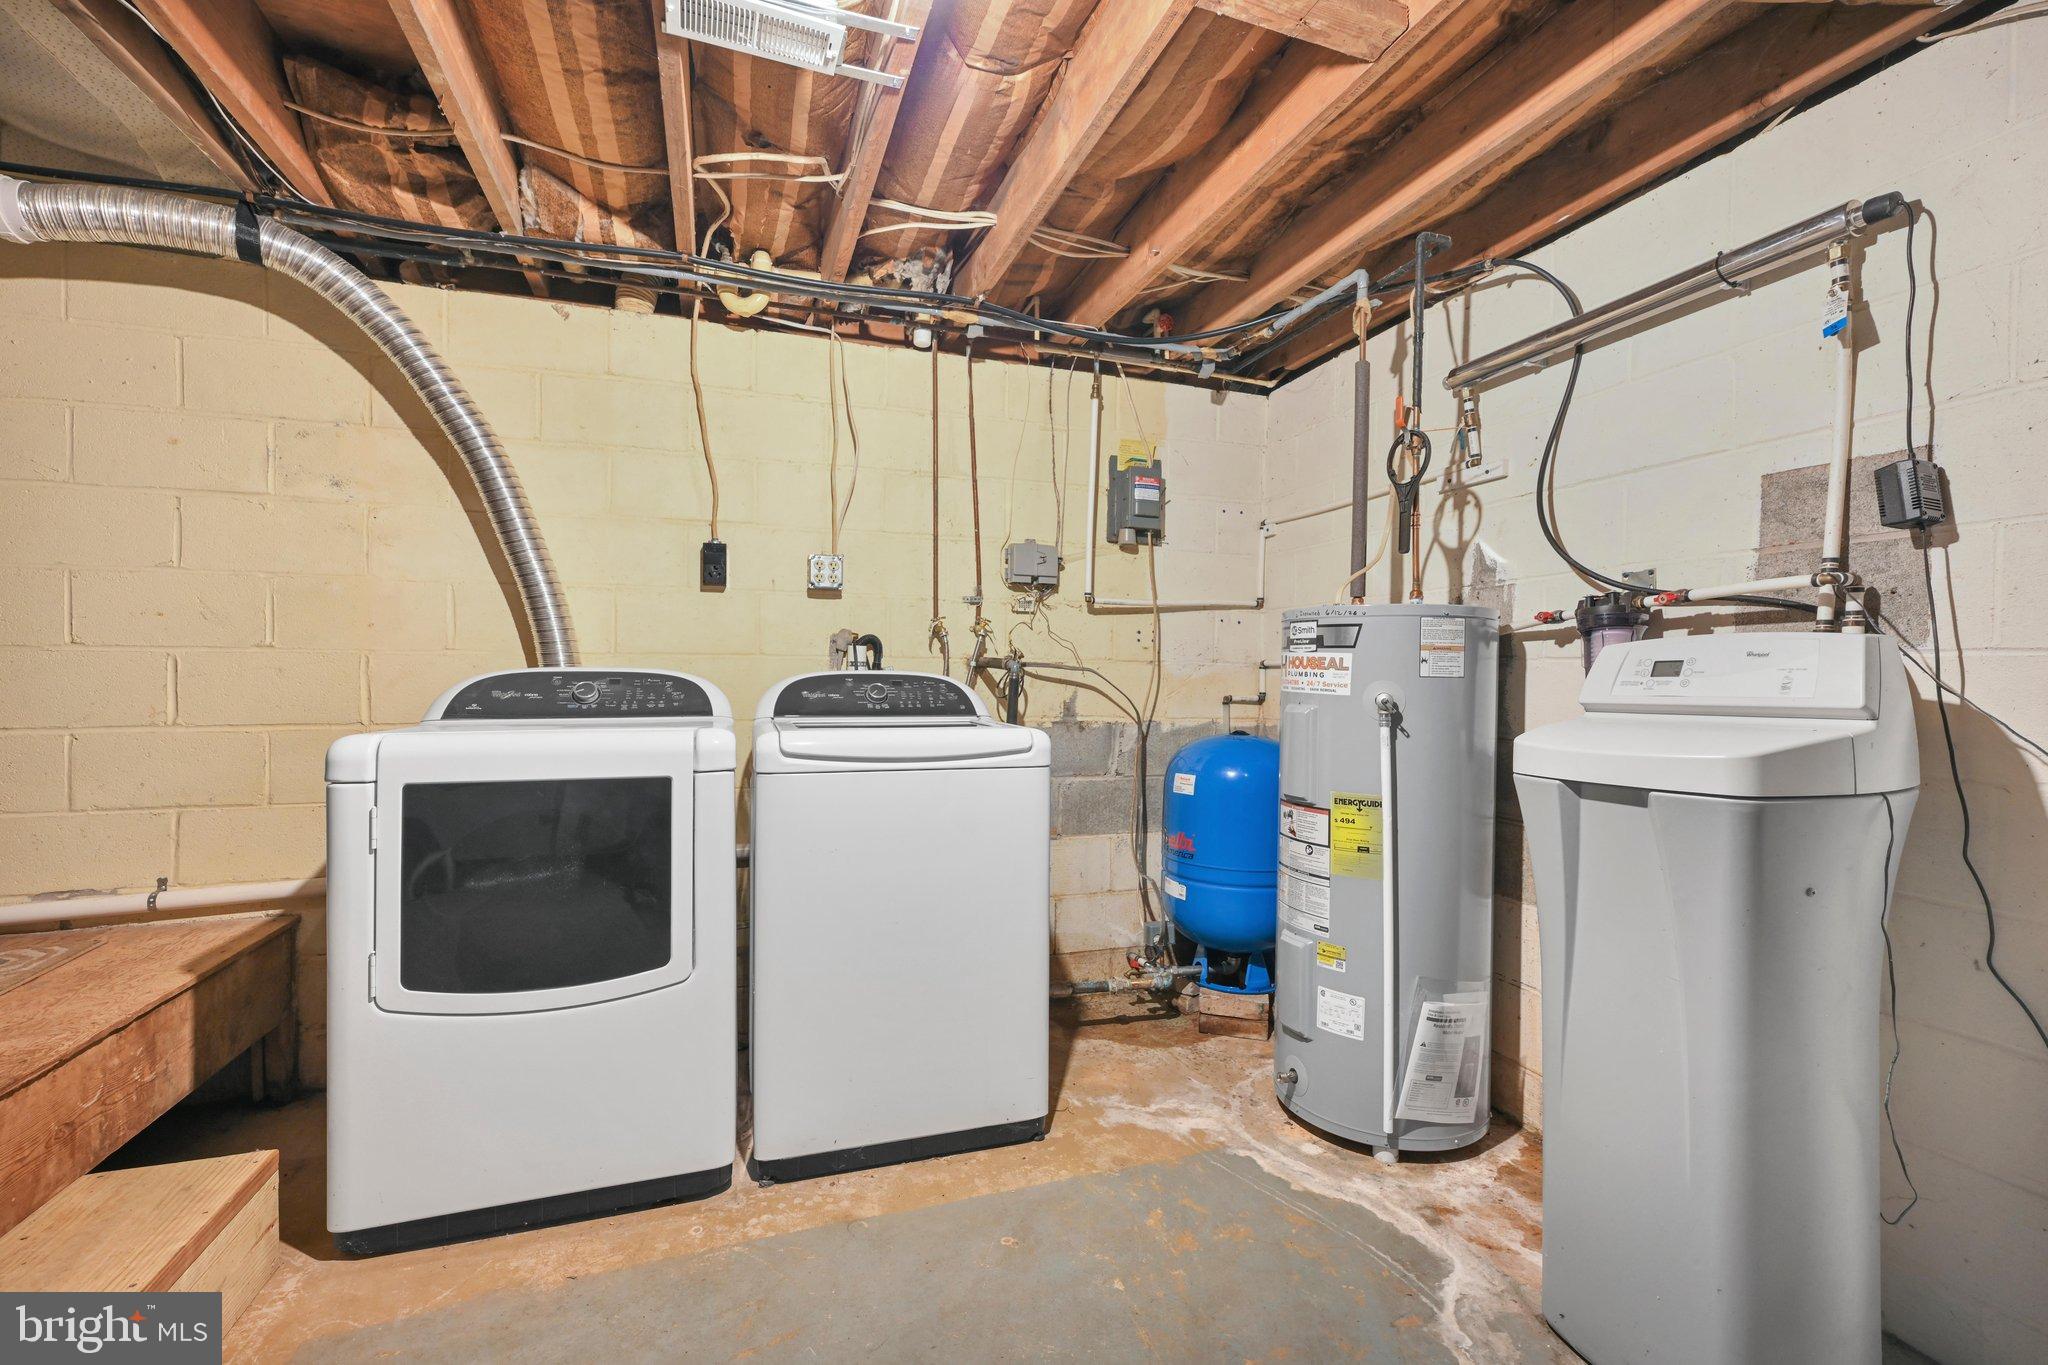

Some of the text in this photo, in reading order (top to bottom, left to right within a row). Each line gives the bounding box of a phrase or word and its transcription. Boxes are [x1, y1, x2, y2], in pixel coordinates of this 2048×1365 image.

[1288, 655, 1350, 672] HOUSEAL
[1287, 671, 1325, 679] PLUMBING
[1322, 681, 1349, 689] Service
